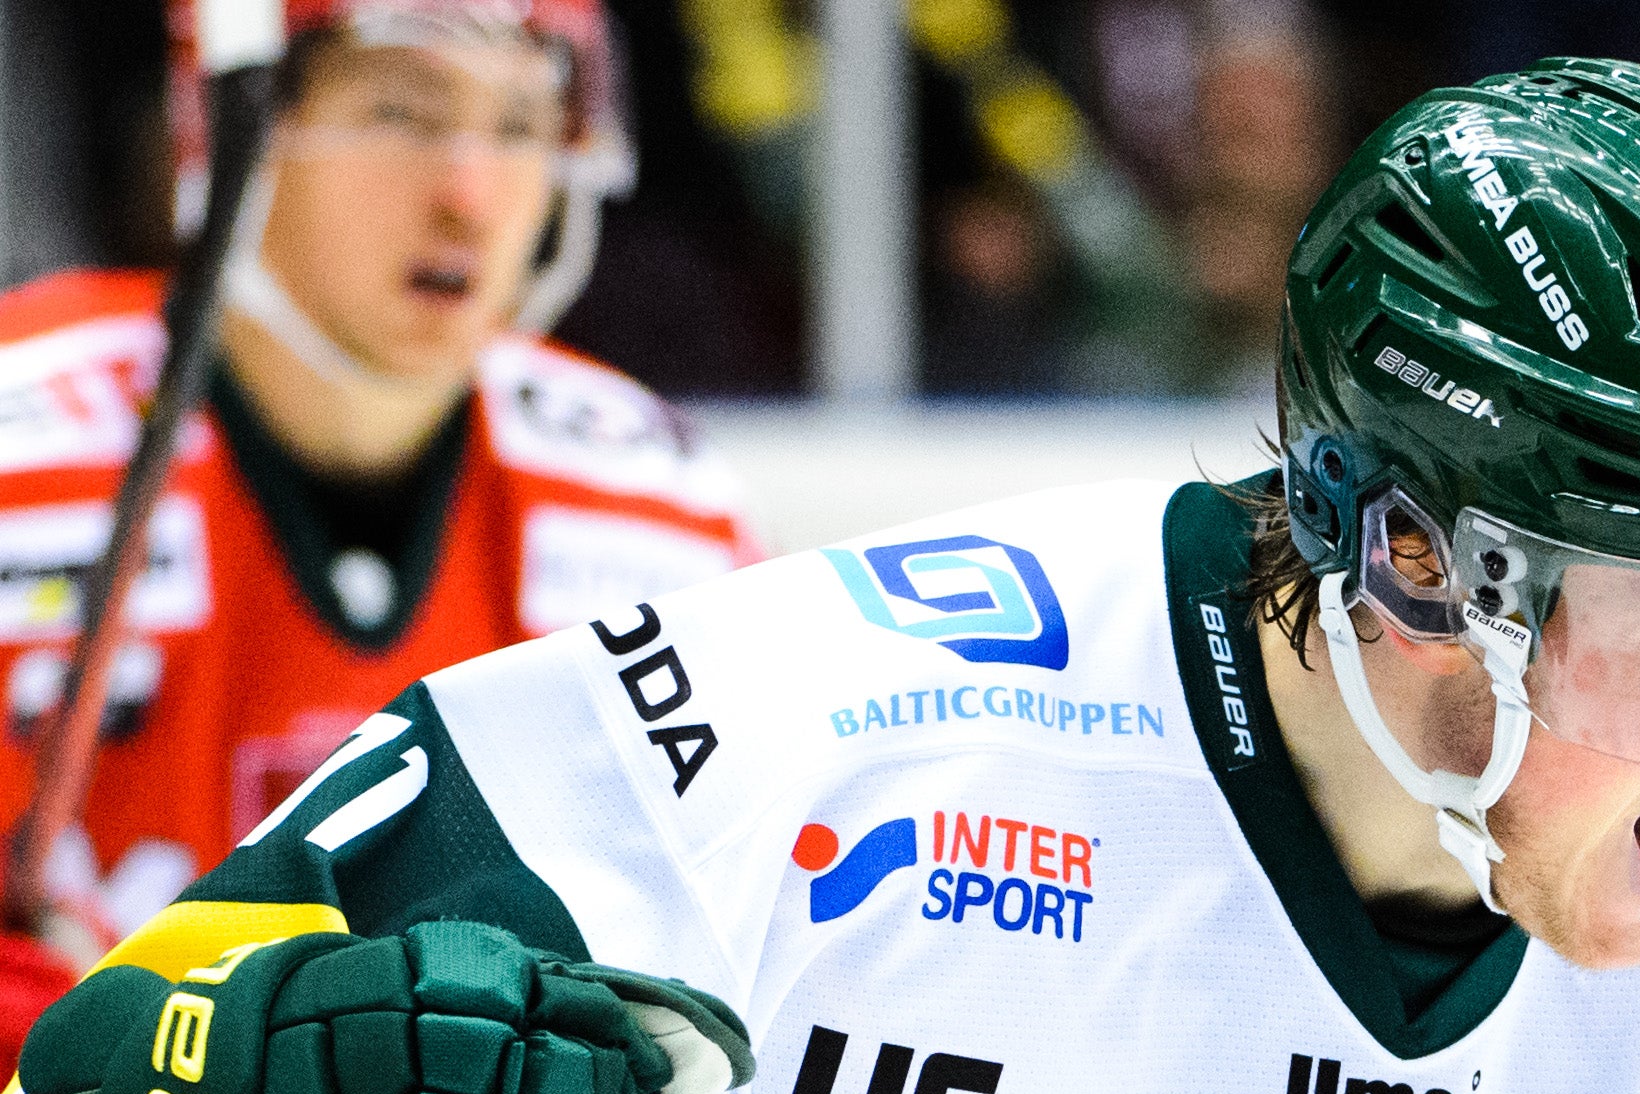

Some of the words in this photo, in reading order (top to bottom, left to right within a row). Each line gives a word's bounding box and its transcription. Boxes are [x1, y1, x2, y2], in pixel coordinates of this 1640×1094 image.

[1503, 225, 1590, 352] BUSS
[829, 685, 1165, 738] BALTICGRUPPEN
[933, 810, 1093, 889] INTER
[921, 868, 1094, 943] SPORT
